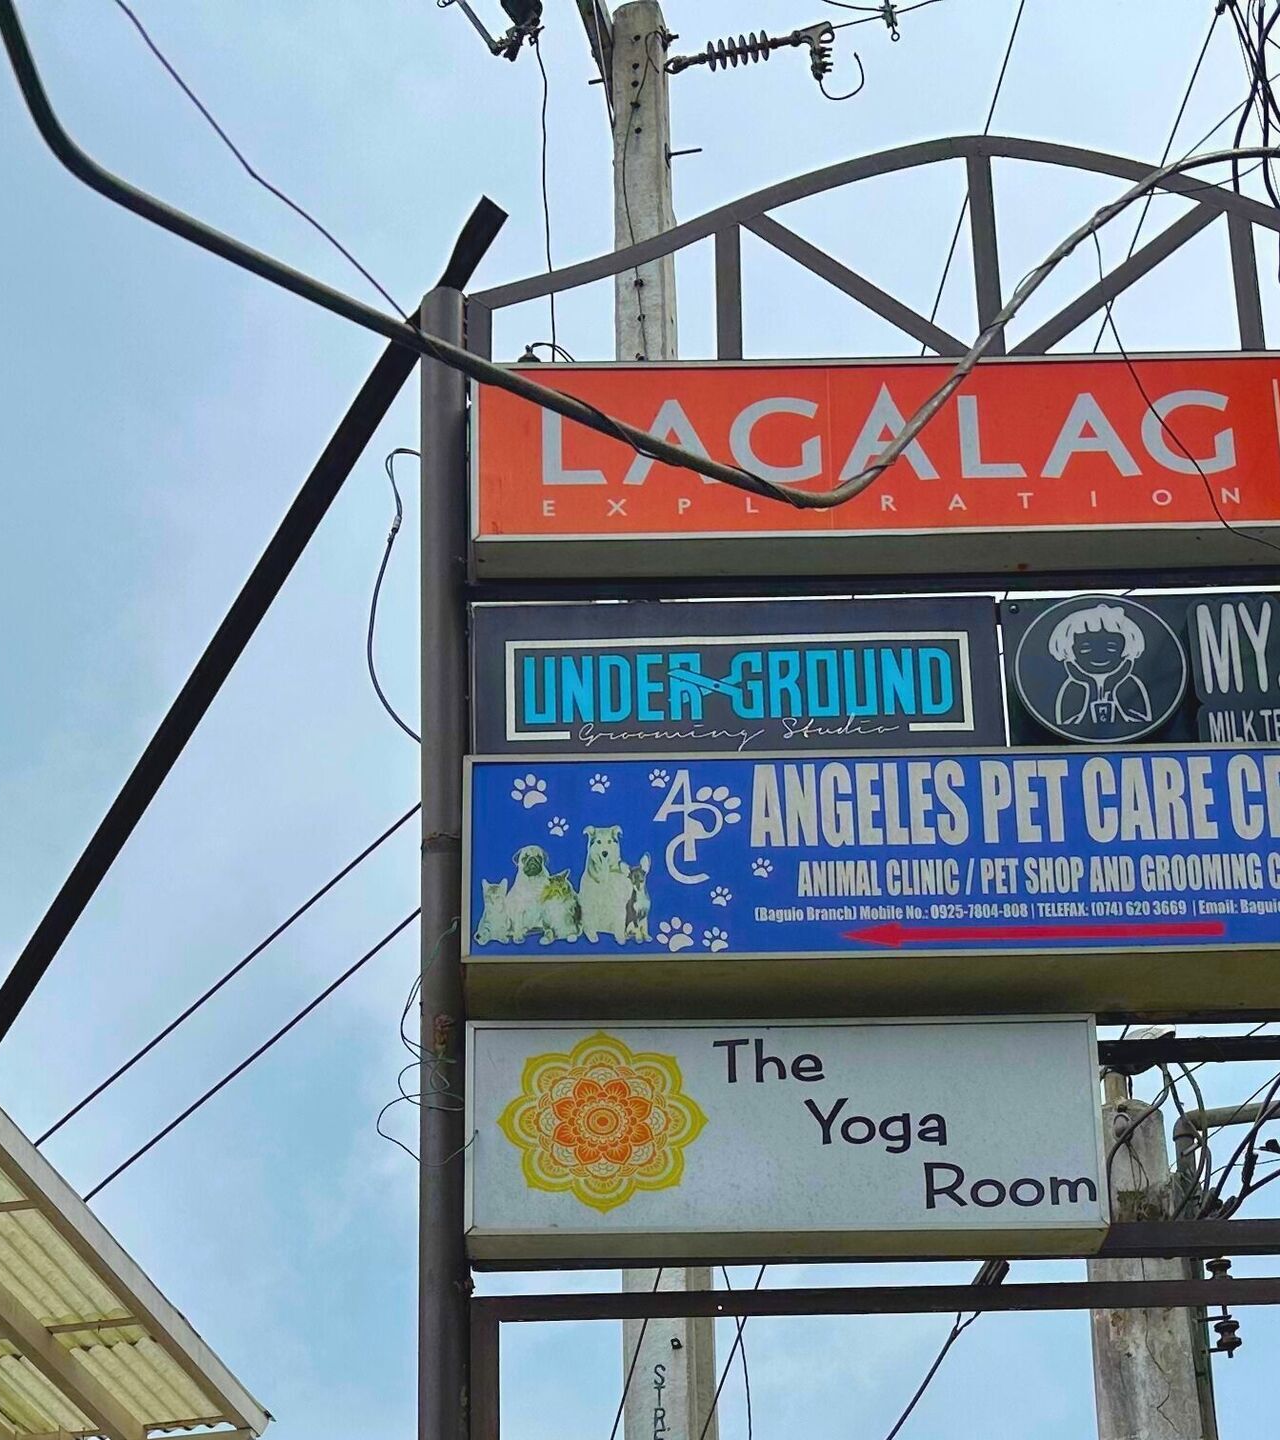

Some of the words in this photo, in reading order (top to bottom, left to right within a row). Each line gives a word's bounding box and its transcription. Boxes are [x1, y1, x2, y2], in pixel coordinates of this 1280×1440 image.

[541, 382, 1237, 486] LAGALAG
[543, 487, 1241, 518] EXPLRATION
[578, 722, 766, 751] Grooming
[782, 712, 900, 739] Studio
[1209, 710, 1255, 742] MILK
[749, 760, 970, 848] ANGELES
[980, 757, 1069, 845] PET
[1081, 755, 1219, 844] CARE
[797, 860, 880, 897] ANIMAL
[886, 858, 959, 897] CLINIC
[981, 857, 1018, 895] PET
[1024, 856, 1082, 894] SHOP
[1089, 856, 1135, 893] AND
[1140, 852, 1261, 892] GROOMING
[754, 906, 804, 922] (Baguio
[806, 905, 857, 921] Branch)
[860, 905, 903, 920] Mobile
[930, 902, 1029, 920] 0925-7804-808
[1038, 902, 1089, 918] TELEFAX:
[1091, 902, 1122, 918] (074)
[1125, 901, 1150, 916] 620
[1153, 901, 1187, 916] 3669
[1199, 900, 1239, 915] Email:
[713, 1037, 826, 1085] The
[805, 1097, 947, 1154] Yoga
[923, 1162, 1098, 1210] Room
